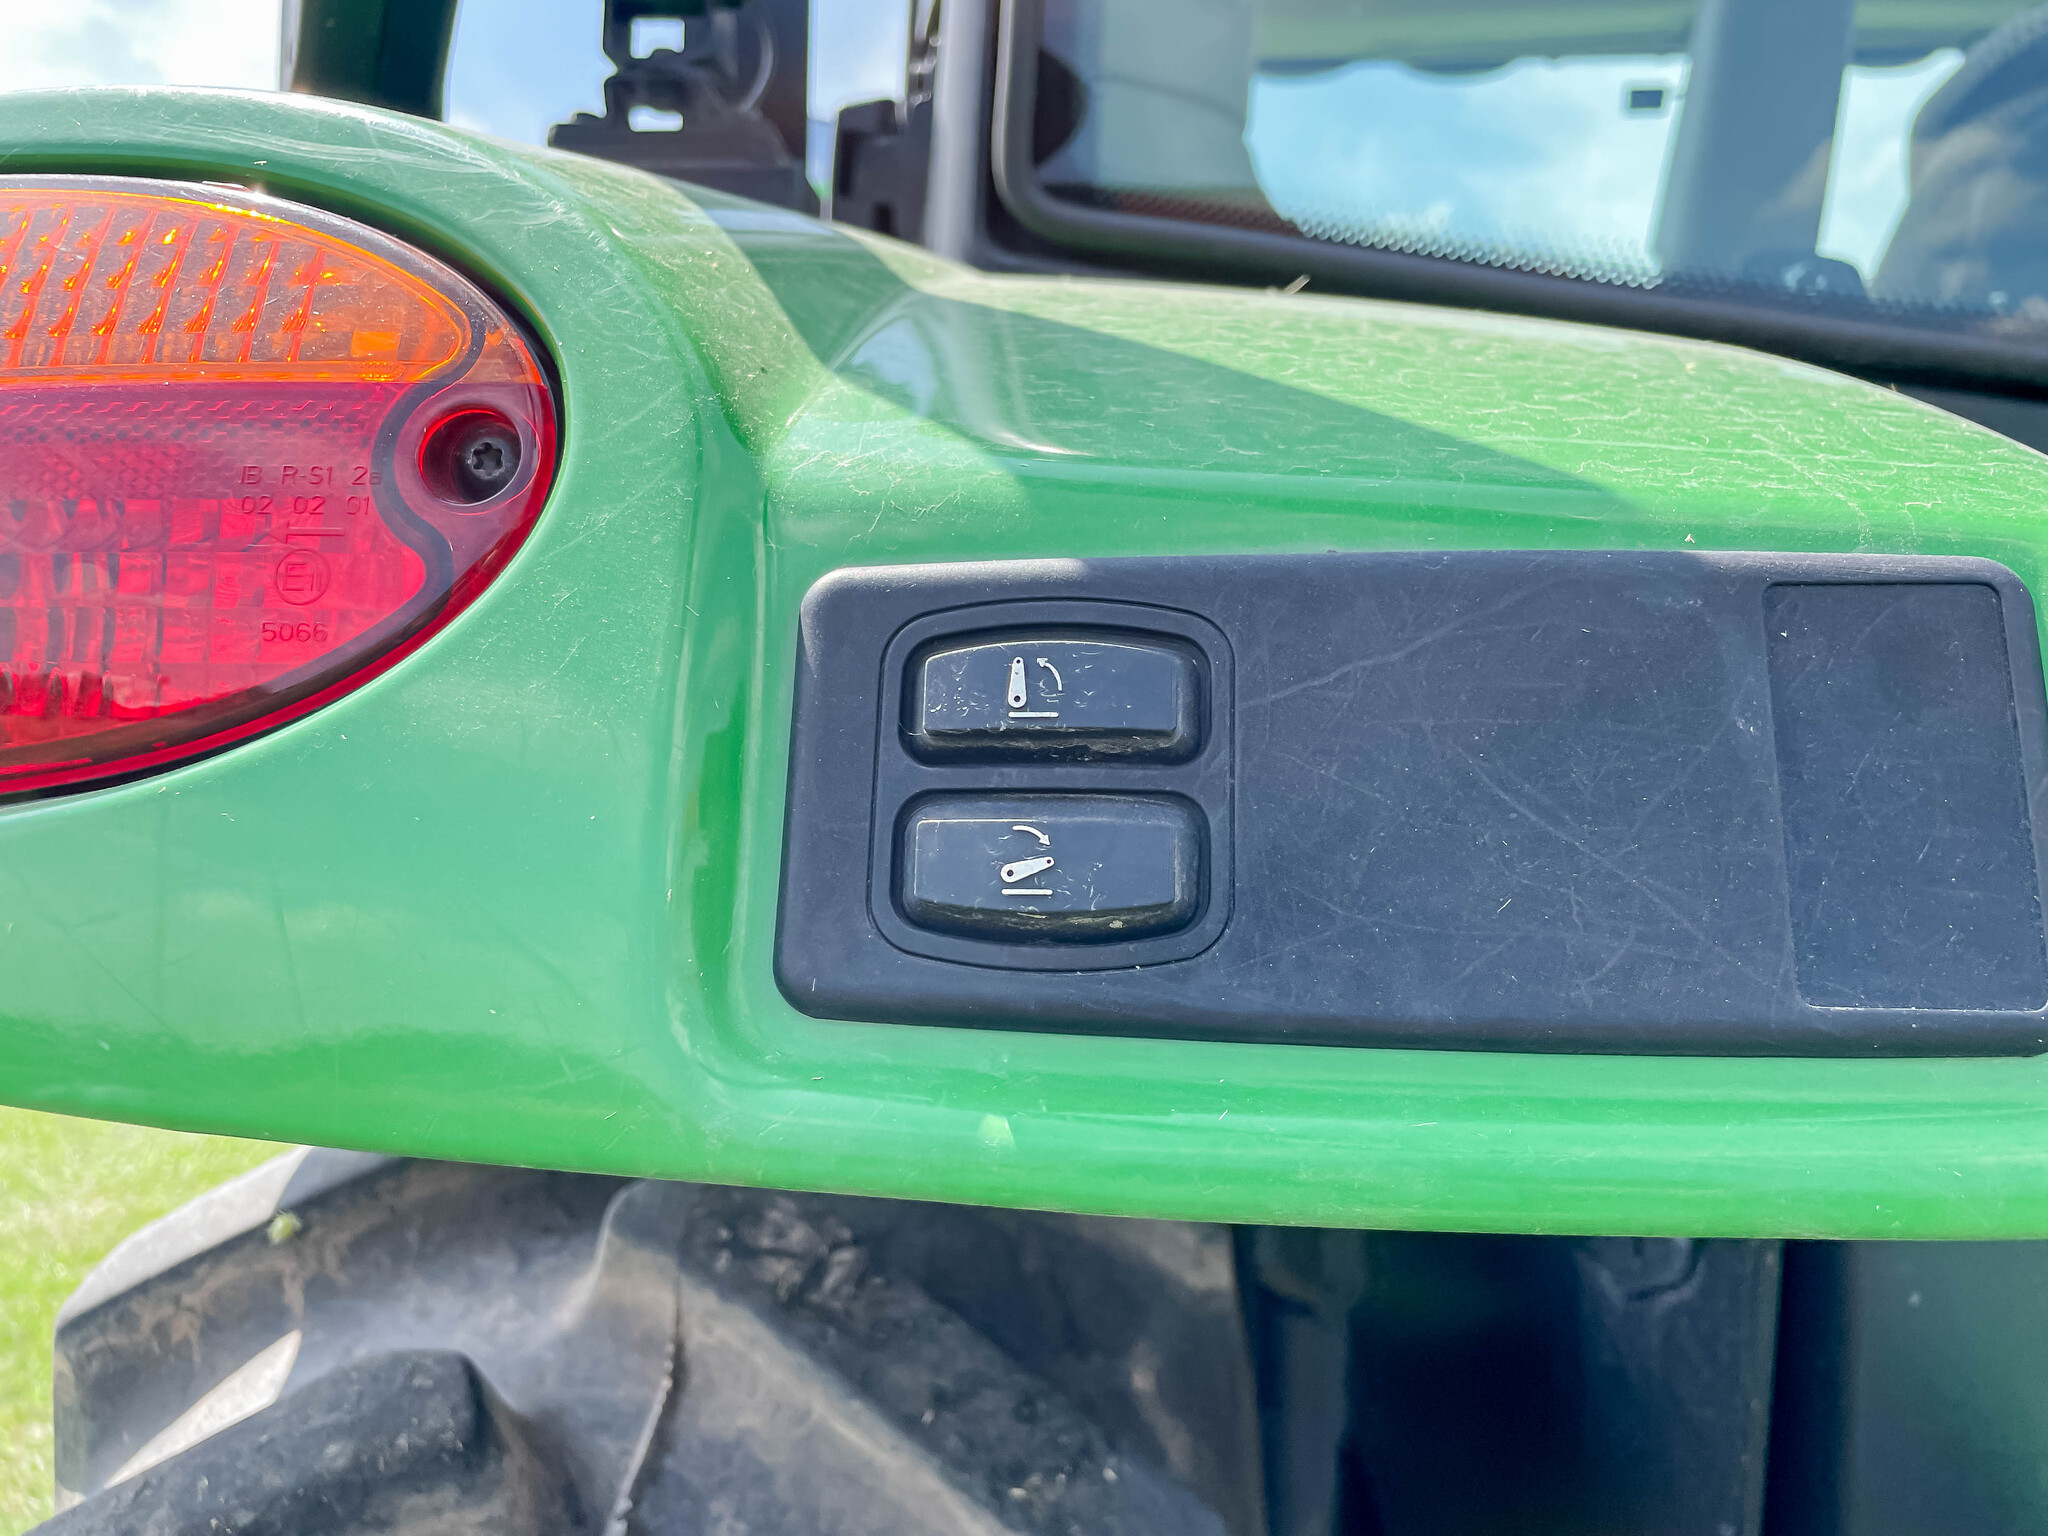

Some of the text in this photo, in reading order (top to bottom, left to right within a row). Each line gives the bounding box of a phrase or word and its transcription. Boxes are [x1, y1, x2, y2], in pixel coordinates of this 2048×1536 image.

[281, 465, 334, 486] R-S1
[241, 496, 371, 516] 02 02 01
[261, 622, 329, 643] 5066
